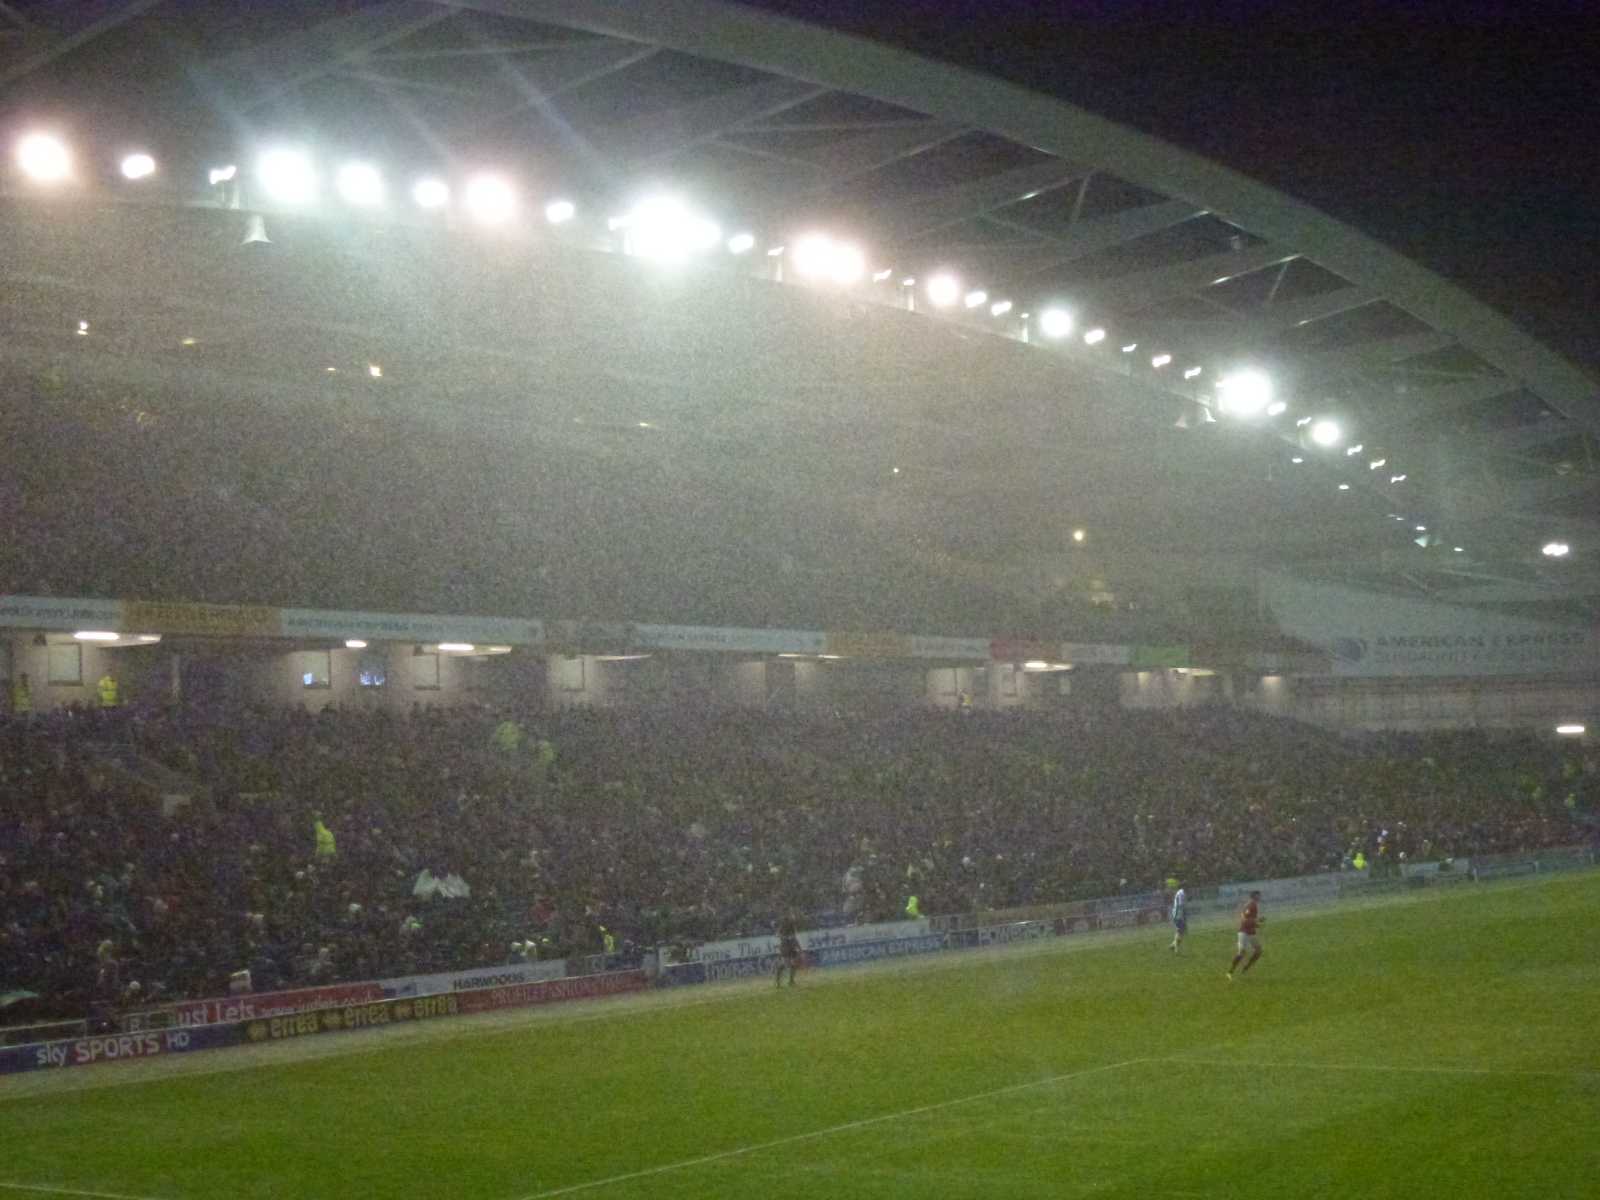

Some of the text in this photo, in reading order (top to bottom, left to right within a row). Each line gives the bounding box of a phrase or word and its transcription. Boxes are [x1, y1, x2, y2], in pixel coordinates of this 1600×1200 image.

[453, 973, 525, 990] HARWOODS
[174, 1003, 208, 1027] ust
[36, 1032, 190, 1066] sky SPORTS HD
